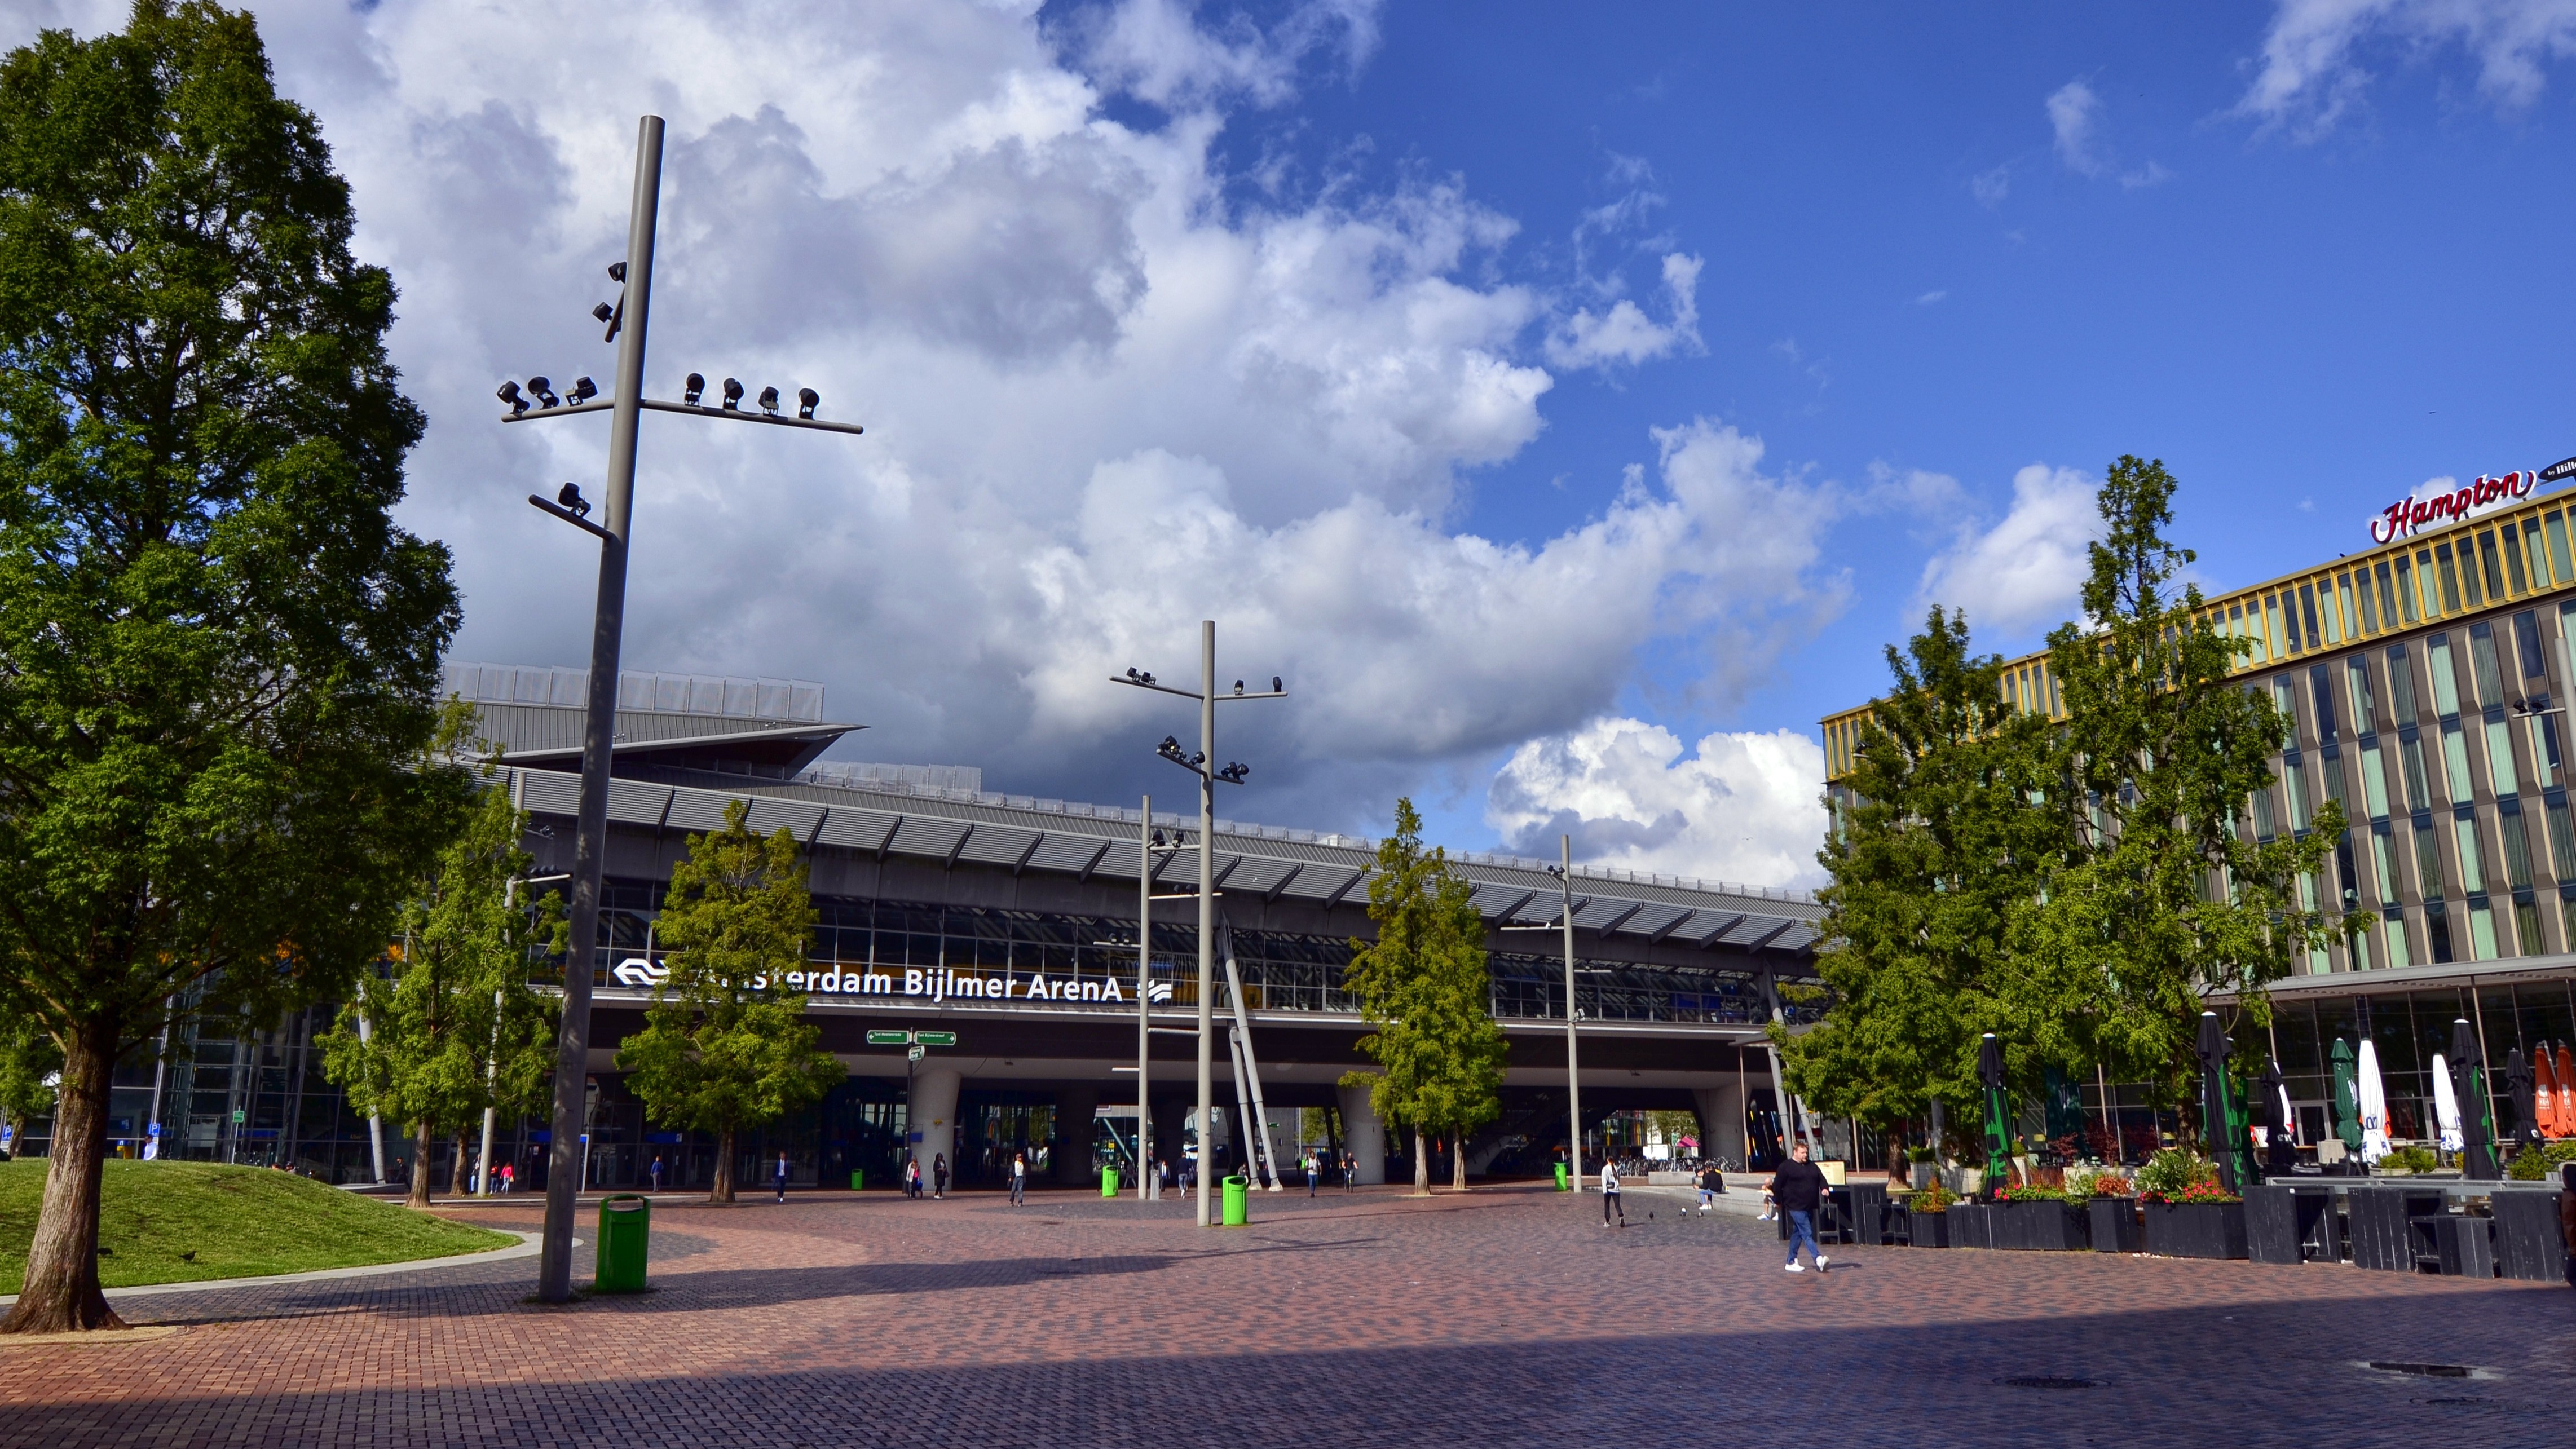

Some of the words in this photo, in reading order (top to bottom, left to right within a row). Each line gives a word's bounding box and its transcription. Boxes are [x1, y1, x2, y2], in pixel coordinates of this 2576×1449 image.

[2370, 471, 2536, 545] Hampton
[905, 968, 1017, 1003] Bijlmer
[1026, 974, 1123, 1002] ArenA
